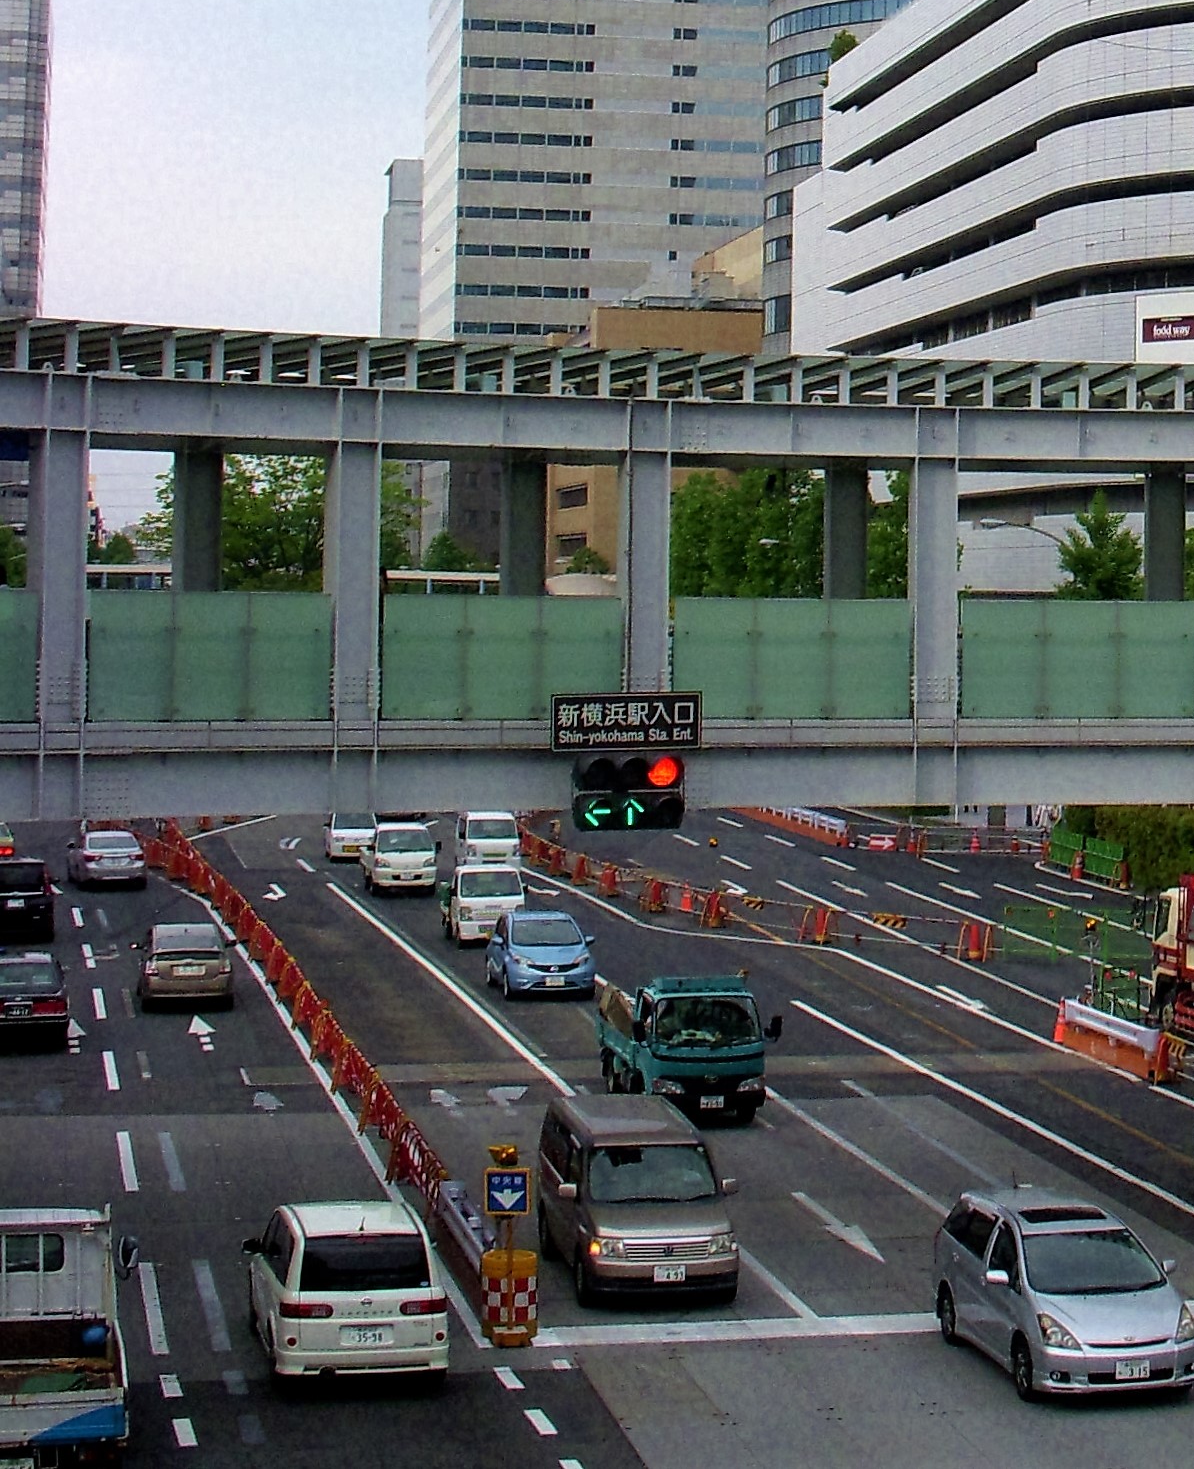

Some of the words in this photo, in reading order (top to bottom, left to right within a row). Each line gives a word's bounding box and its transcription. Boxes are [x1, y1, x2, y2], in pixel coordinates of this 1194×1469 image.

[557, 702, 695, 728] 新横浜駅入口
[559, 729, 645, 745] Shin-yokohama
[648, 728, 669, 741] Sta.
